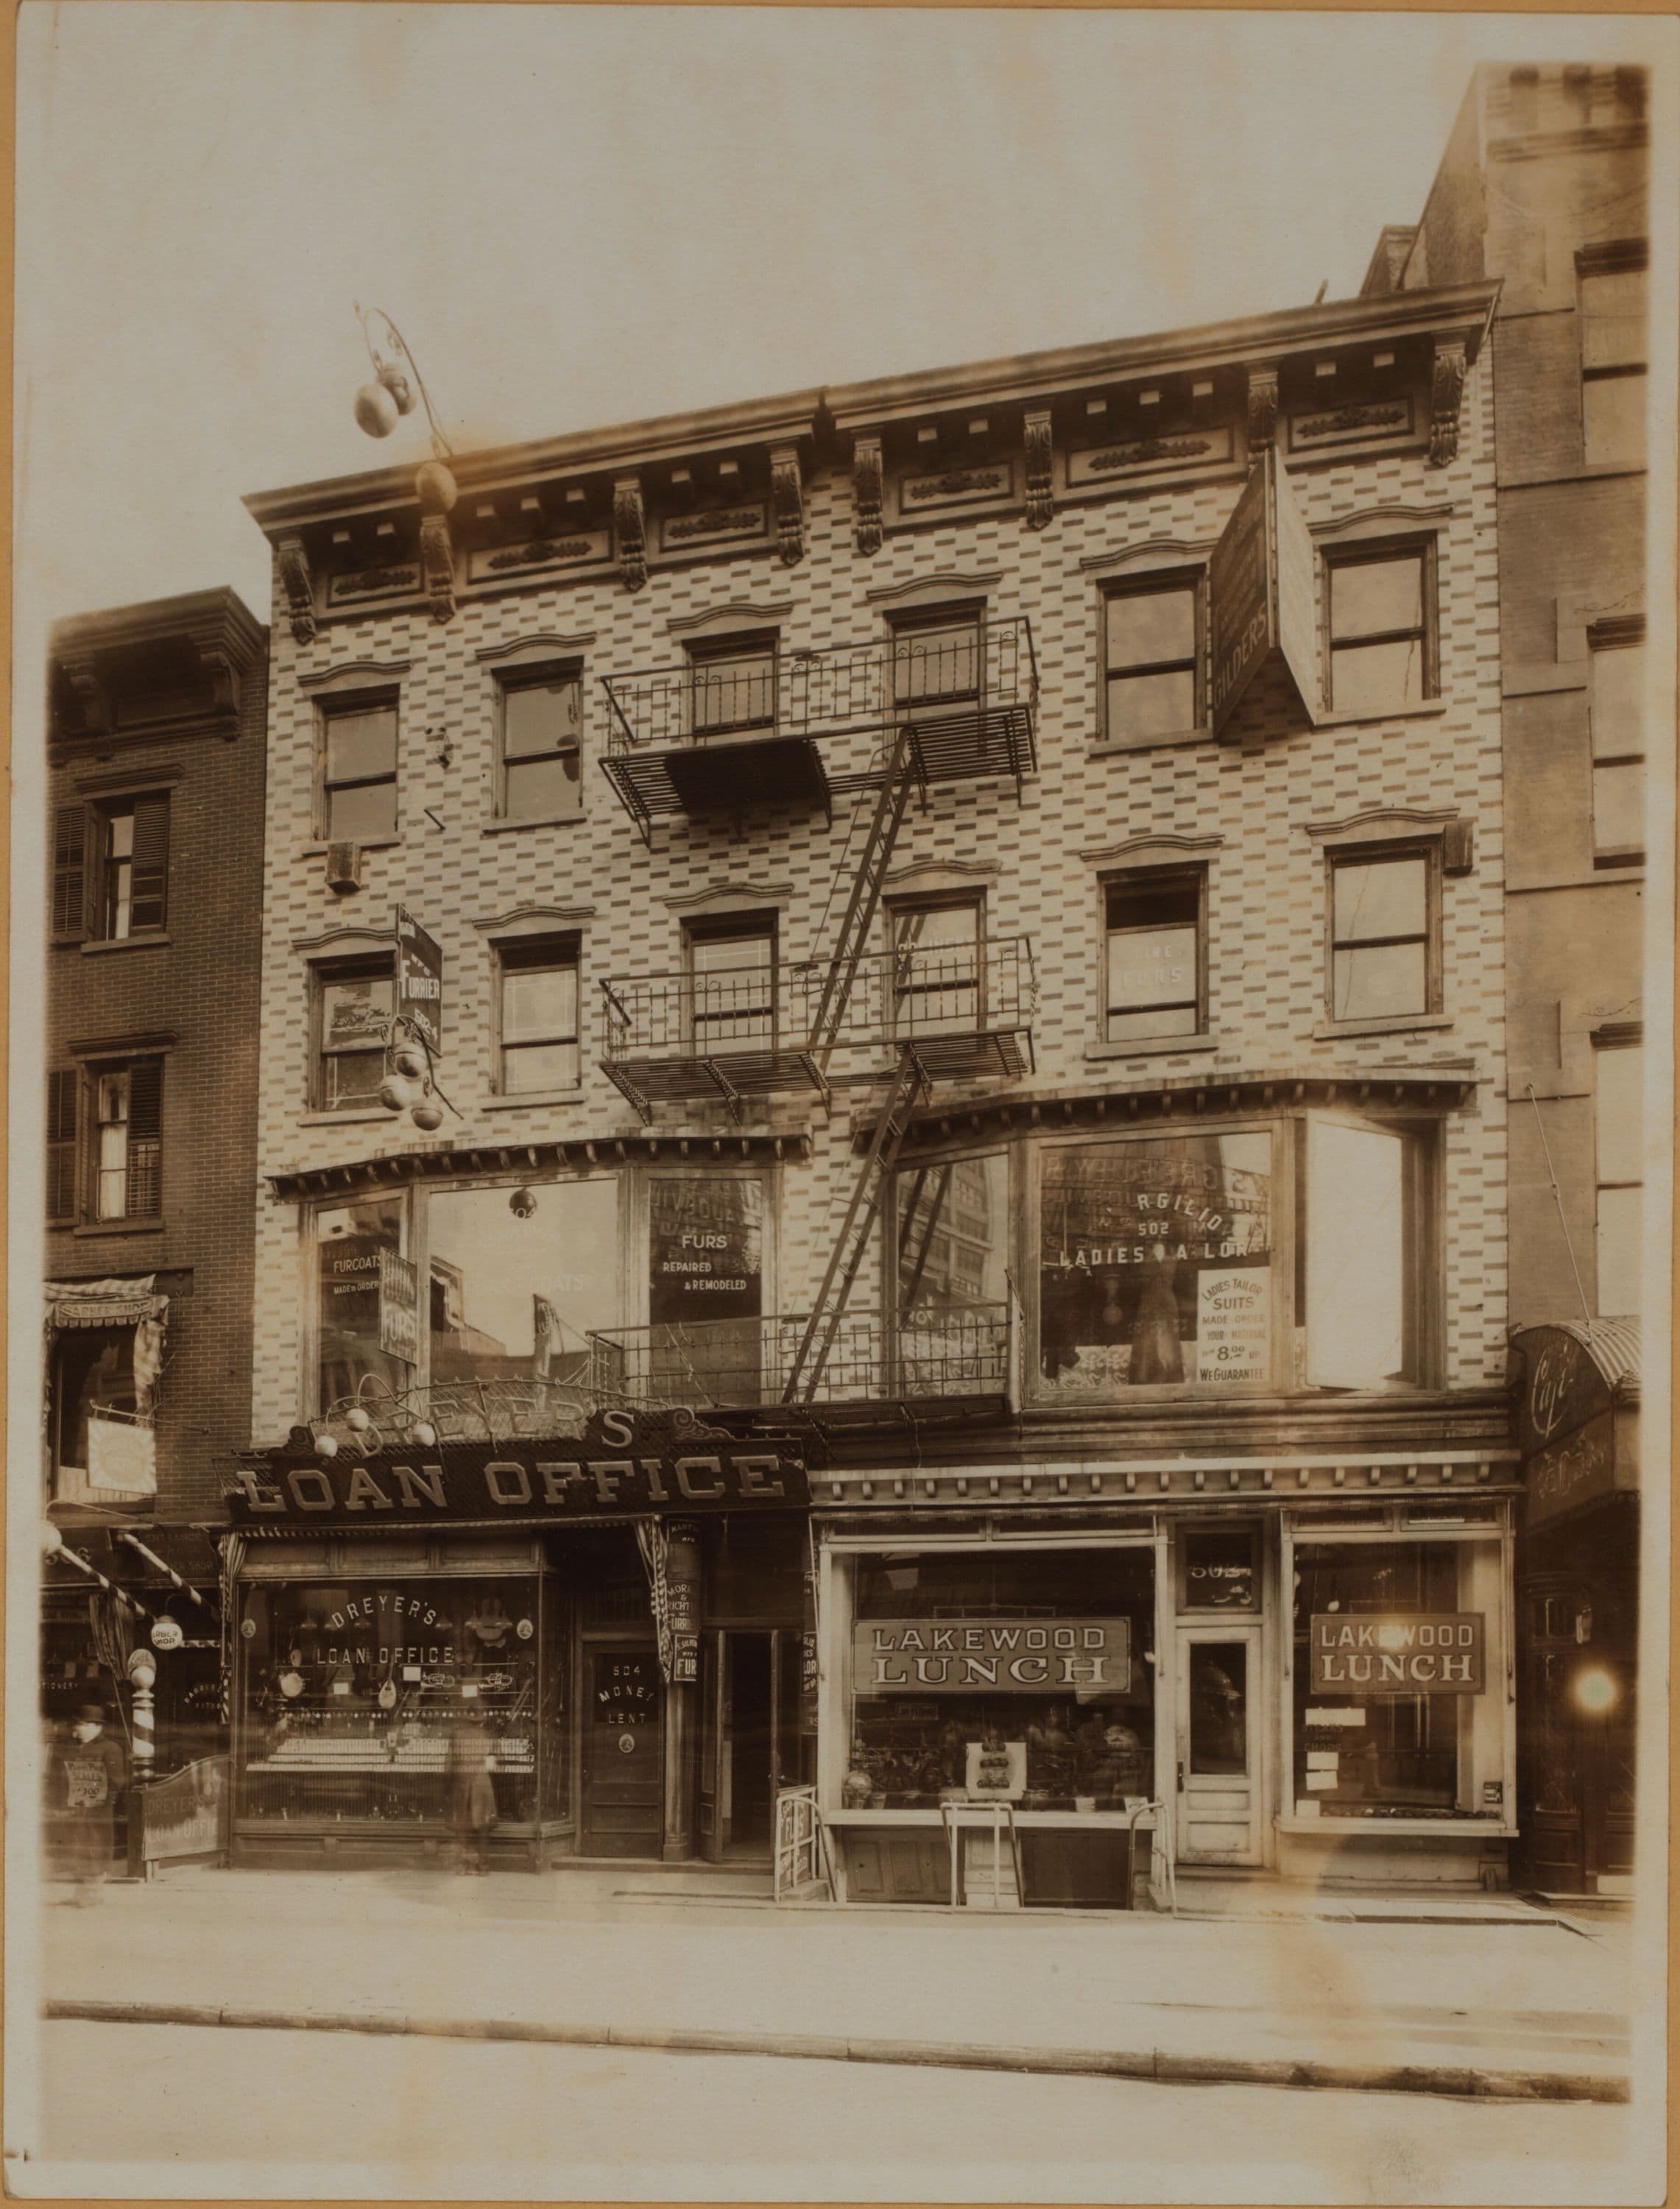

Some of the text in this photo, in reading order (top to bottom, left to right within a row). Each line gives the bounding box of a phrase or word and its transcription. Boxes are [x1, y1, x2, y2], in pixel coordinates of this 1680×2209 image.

[1215, 599, 1268, 711] GILDERS
[401, 959, 440, 999] FURRIER
[1137, 1192, 1223, 1231] RGILIO
[1138, 1221, 1169, 1236] 502
[681, 1234, 728, 1249] FURS
[663, 1261, 712, 1272] REPAIRED
[1059, 1246, 1145, 1268] LADIES
[333, 1284, 351, 1296] MADE
[356, 1280, 379, 1292] ORDER
[684, 1279, 747, 1290] & REMODELED
[1201, 1279, 1263, 1301] LADIES TAILOR
[1213, 1296, 1254, 1310] SUITS
[1202, 1315, 1227, 1326] MADE
[1207, 1330, 1224, 1340] YOUR
[236, 1454, 786, 1512] LOAN OFFICE
[331, 1595, 437, 1629] DREYER'S
[872, 1627, 1105, 1651] LAKEWOOD
[1320, 1625, 1473, 1647] LAKWOOD
[317, 1647, 454, 1664] LOAN OFFICE
[613, 1666, 641, 1677] 504
[870, 1655, 1111, 1684] LUNCH
[1320, 1654, 1474, 1682] LUNCH
[599, 1685, 654, 1703] MONEY
[608, 1713, 646, 1724] LENT
[147, 1796, 205, 1815] DREYER'S
[183, 1817, 218, 1838] OFFIC
